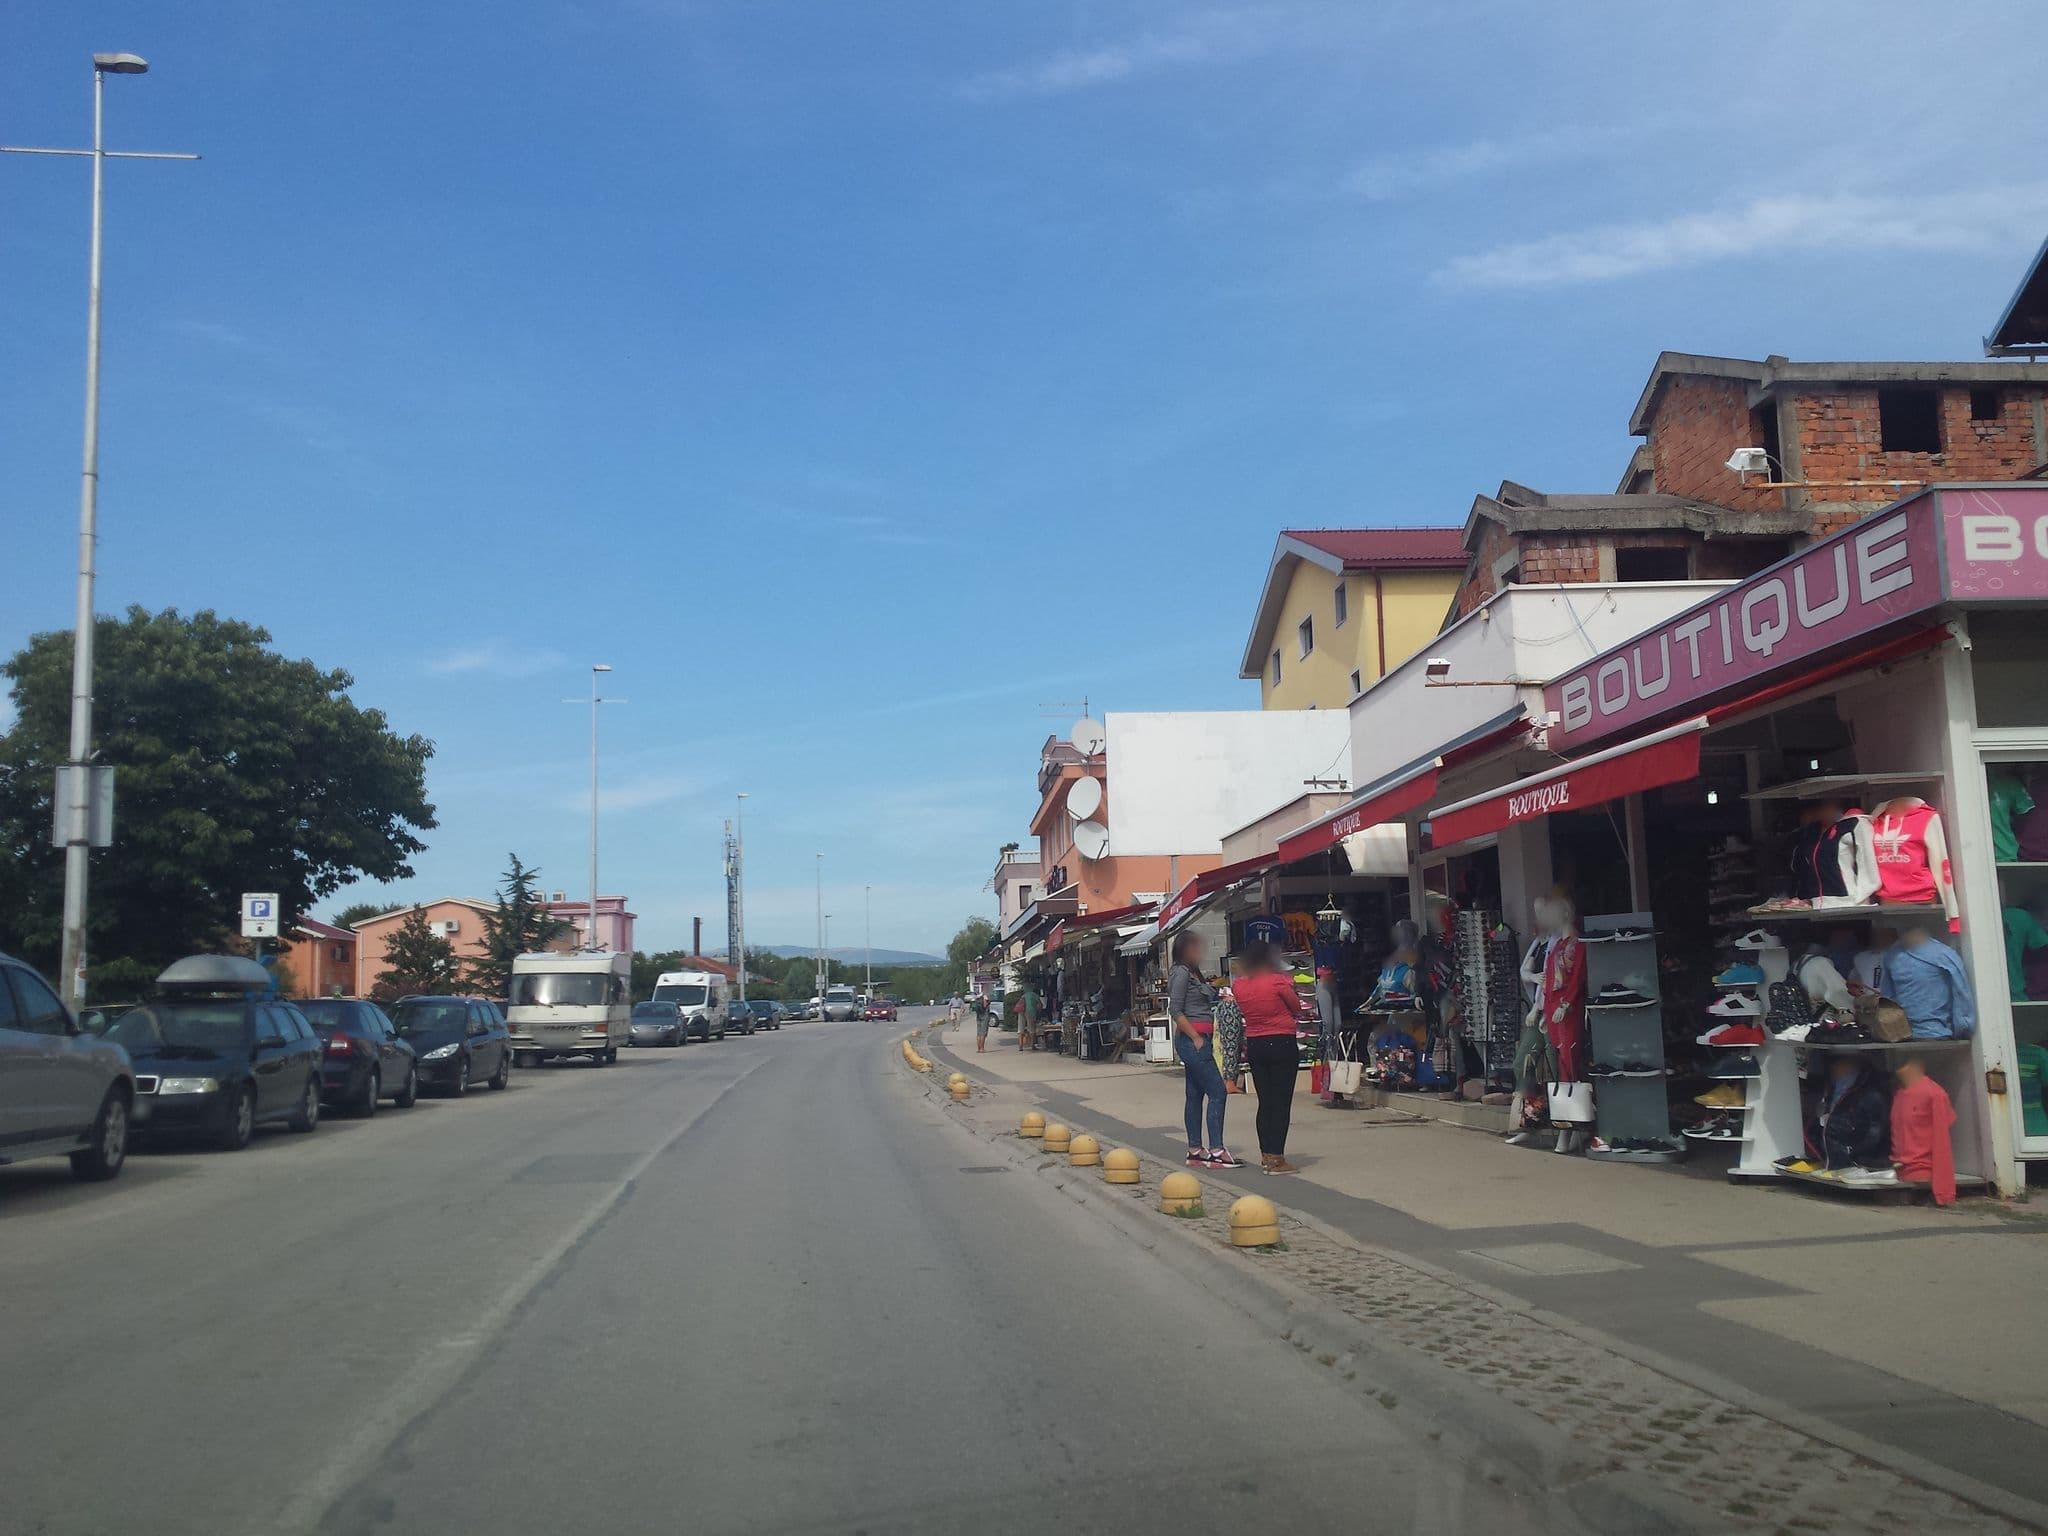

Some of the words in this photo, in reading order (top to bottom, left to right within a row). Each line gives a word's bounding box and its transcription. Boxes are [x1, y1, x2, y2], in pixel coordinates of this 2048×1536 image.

[1962, 514, 2048, 561] B
[1561, 511, 1914, 733] BOUTIQUE
[1508, 780, 1569, 820] BOUTIQUE
[1876, 853, 1911, 864] didas
